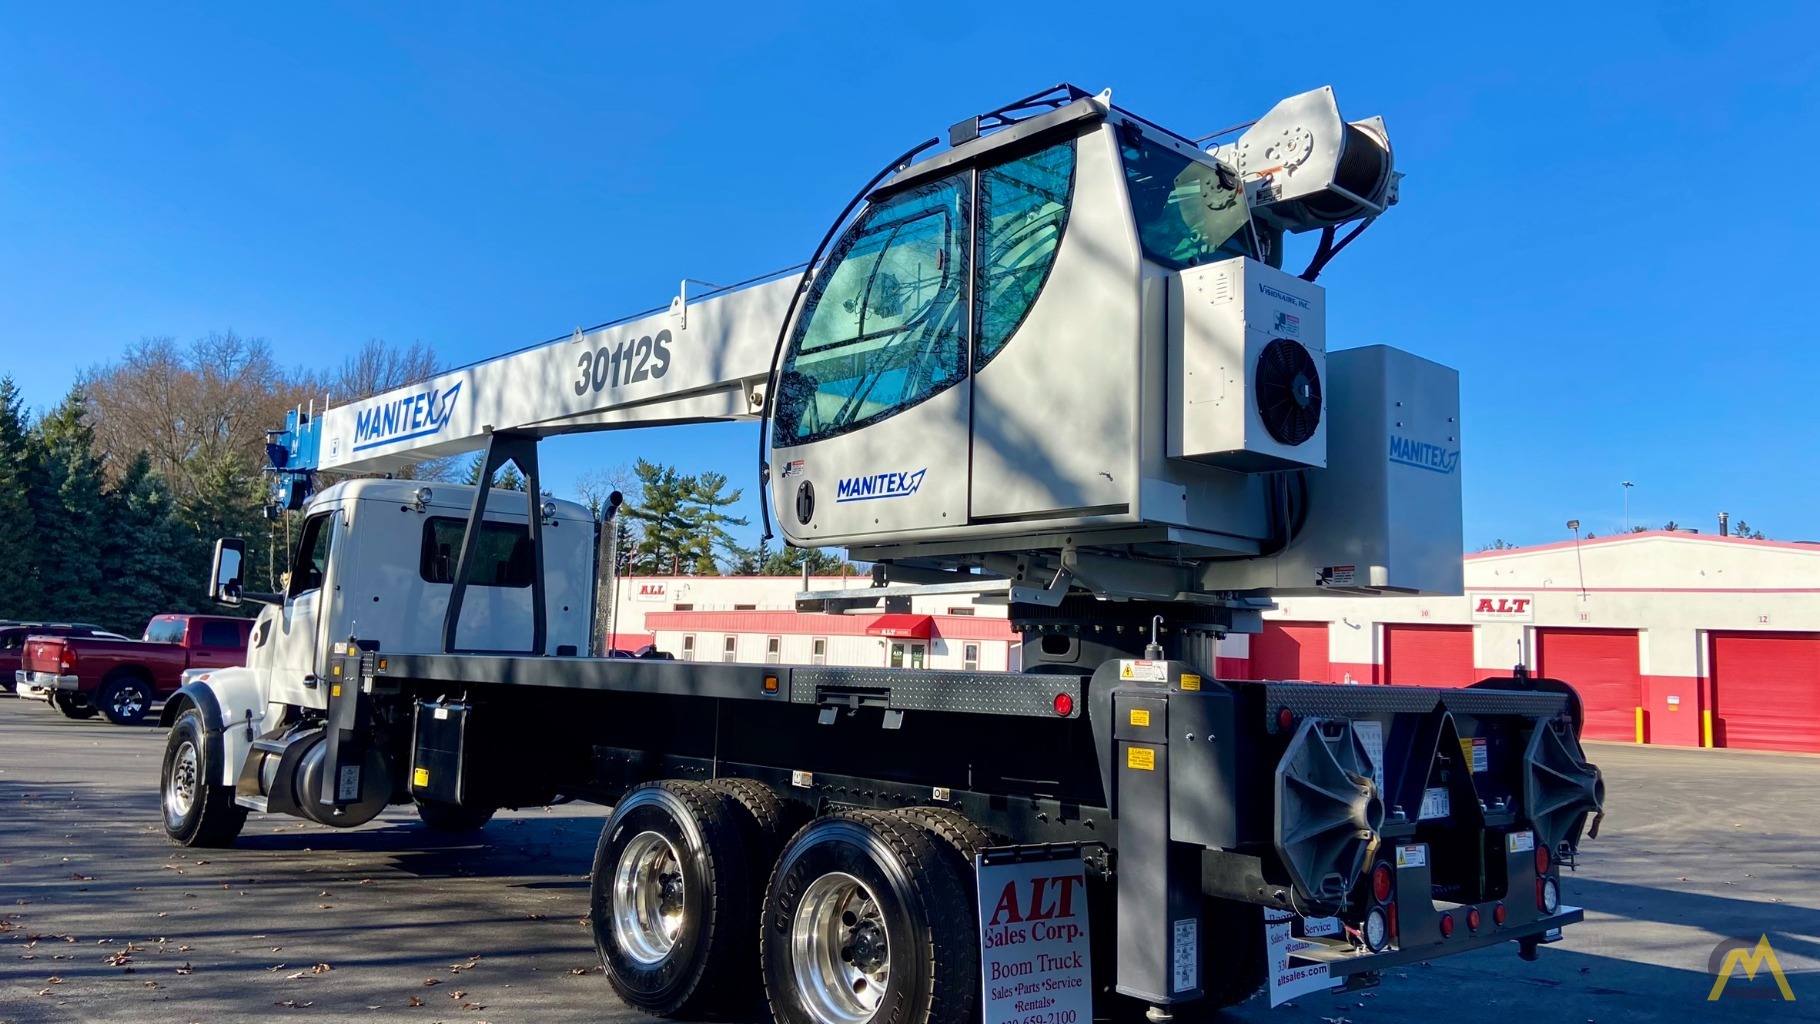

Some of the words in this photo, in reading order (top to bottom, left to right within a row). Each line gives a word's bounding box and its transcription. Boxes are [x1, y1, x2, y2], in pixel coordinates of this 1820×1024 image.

[1299, 300, 1310, 310] INC.
[575, 329, 672, 396] 30112S
[354, 389, 439, 444] MANITEX
[1389, 435, 1448, 469] MANITEX
[837, 471, 908, 498] MANITEX
[1475, 599, 1531, 613] ALT
[1580, 613, 1588, 621] 11
[1759, 615, 1768, 623] 12
[989, 875, 1084, 926] ALT
[984, 925, 1027, 949] Sales
[1031, 921, 1085, 944] Corp.
[1270, 933, 1284, 945] Sales
[1305, 923, 1332, 935] Service
[991, 960, 1033, 980] Boom
[1037, 950, 1083, 973] Truck
[1277, 965, 1327, 986] altsales.com
[992, 986, 1012, 1001] Sales
